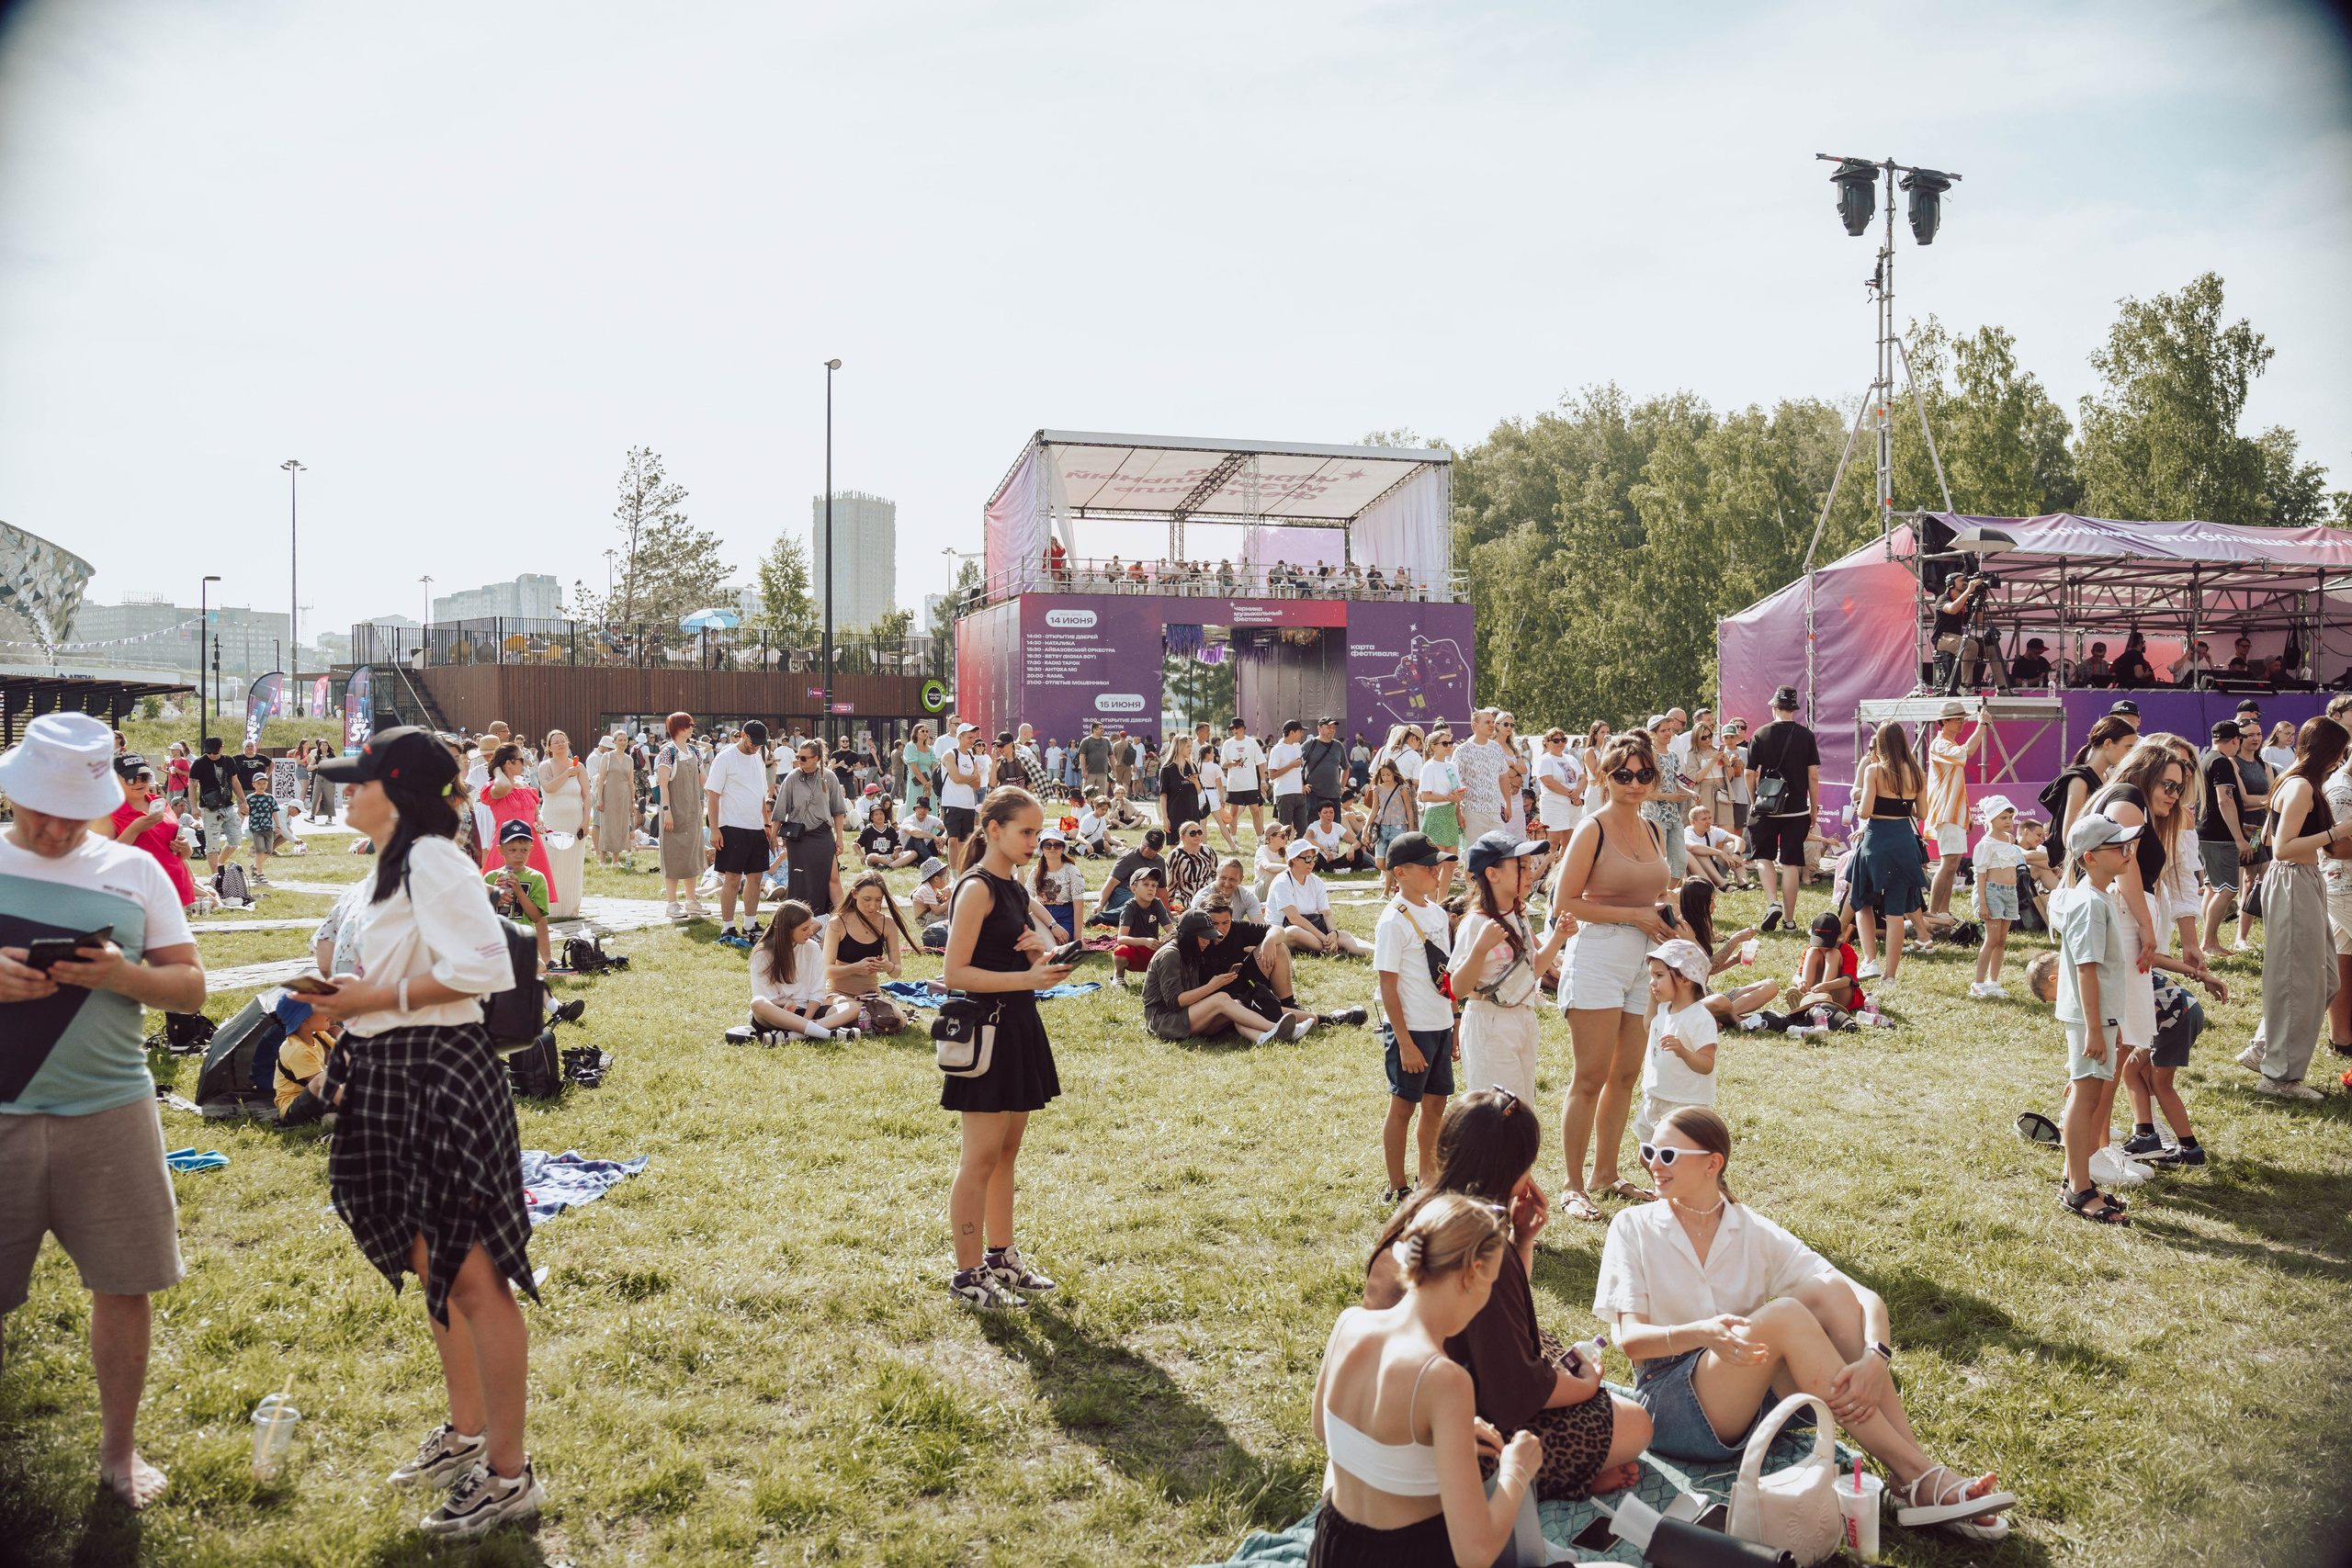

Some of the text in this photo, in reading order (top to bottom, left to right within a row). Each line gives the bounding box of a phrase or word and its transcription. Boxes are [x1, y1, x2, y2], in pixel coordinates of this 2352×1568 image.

[2153, 534, 2198, 543] это
[2198, 532, 2295, 547] больше
[2294, 539, 2343, 547] чем
